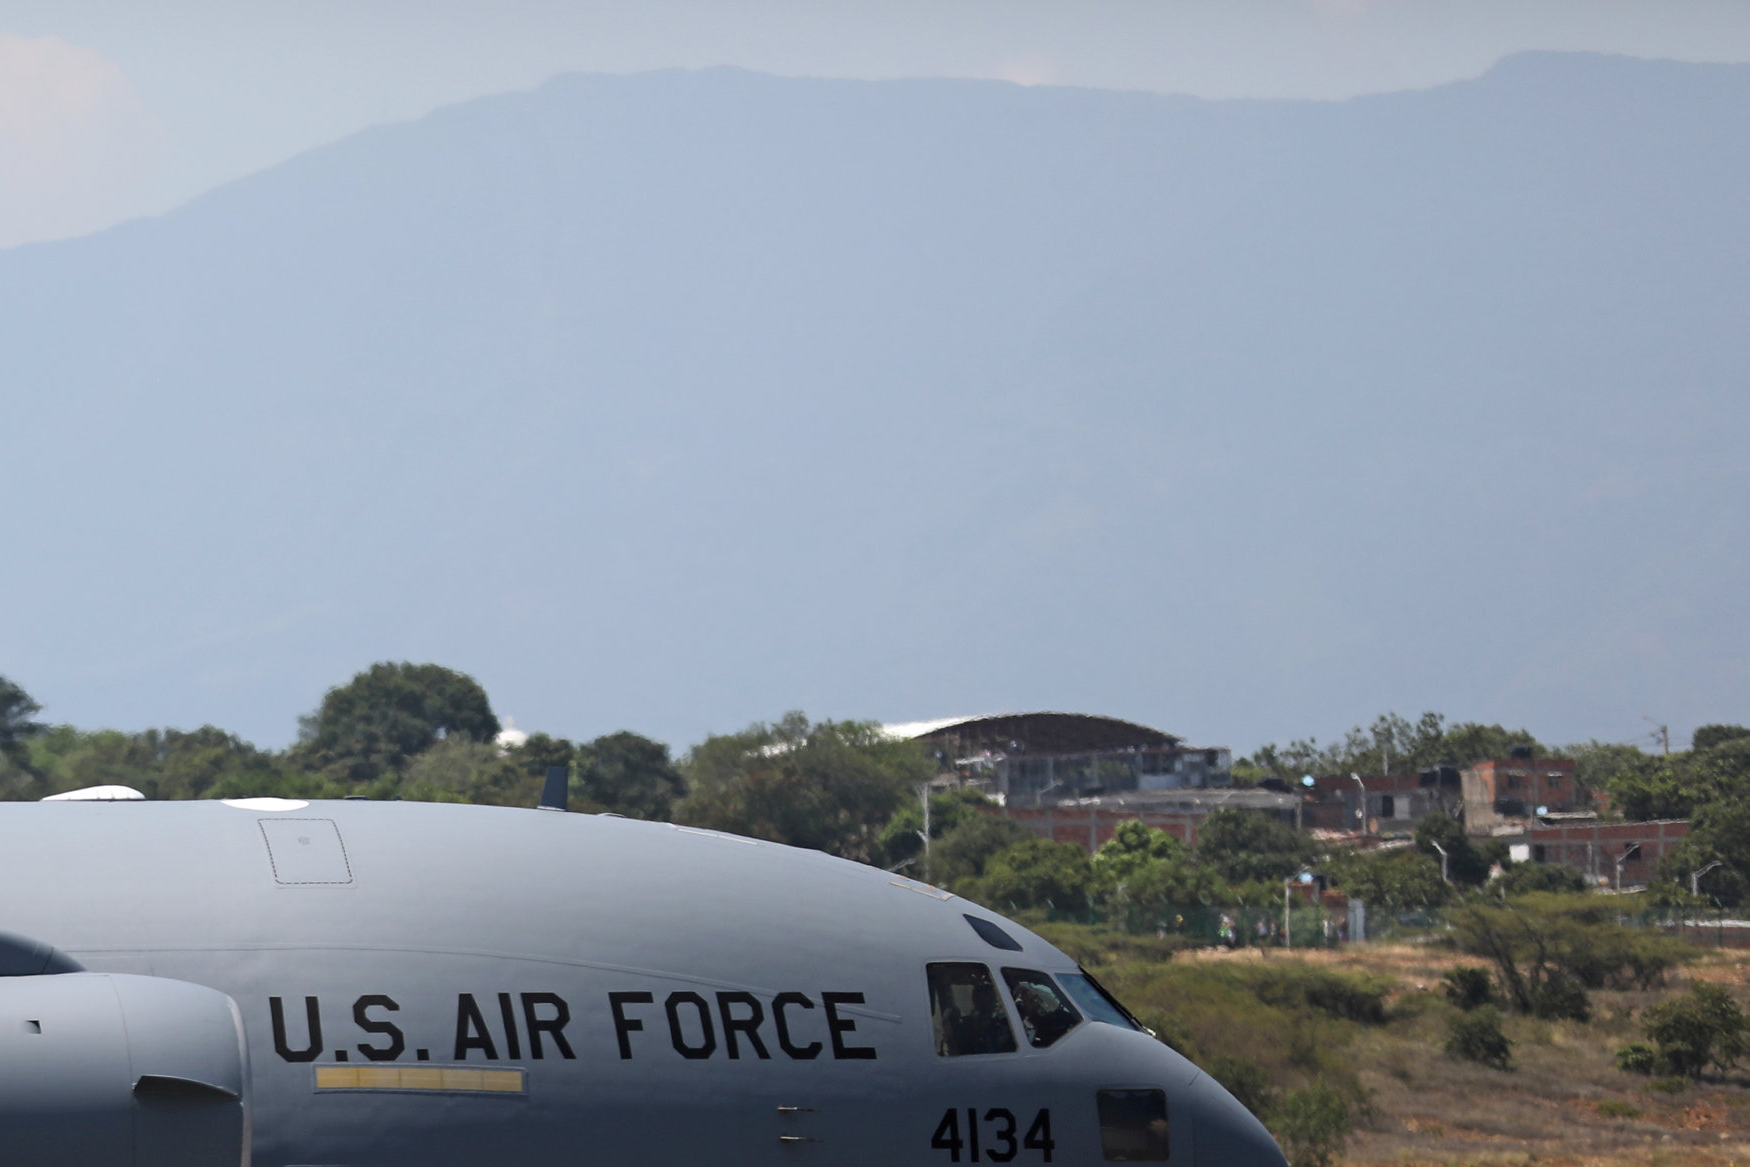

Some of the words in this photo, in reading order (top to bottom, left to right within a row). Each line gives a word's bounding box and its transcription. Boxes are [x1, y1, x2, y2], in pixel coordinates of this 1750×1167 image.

[269, 994, 430, 1063] U.S.
[454, 992, 577, 1060] AIR
[608, 991, 877, 1060] FORCE
[931, 1108, 1055, 1163] 4134
